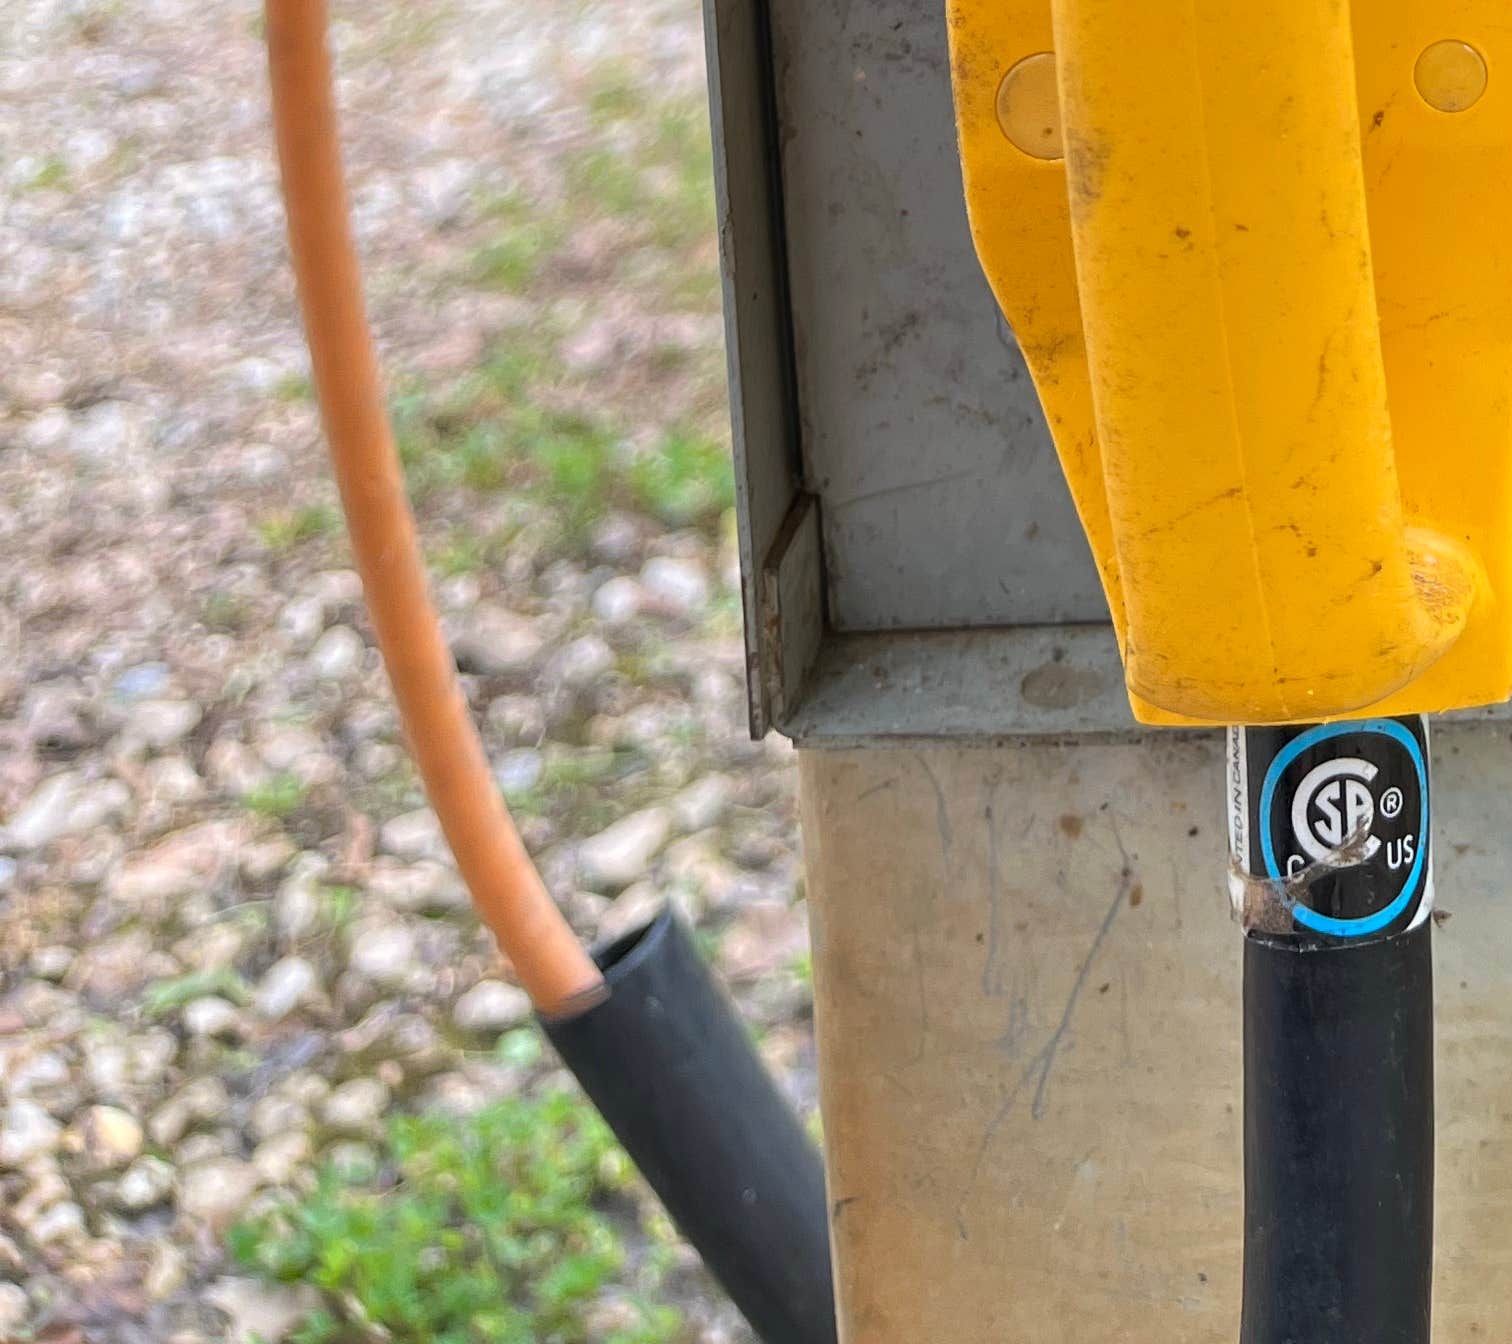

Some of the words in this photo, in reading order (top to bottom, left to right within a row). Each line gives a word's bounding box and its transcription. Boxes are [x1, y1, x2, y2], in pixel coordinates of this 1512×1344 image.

[1231, 725, 1242, 786] CANAD
[1232, 787, 1243, 811] IN
[1386, 833, 1415, 870] US
